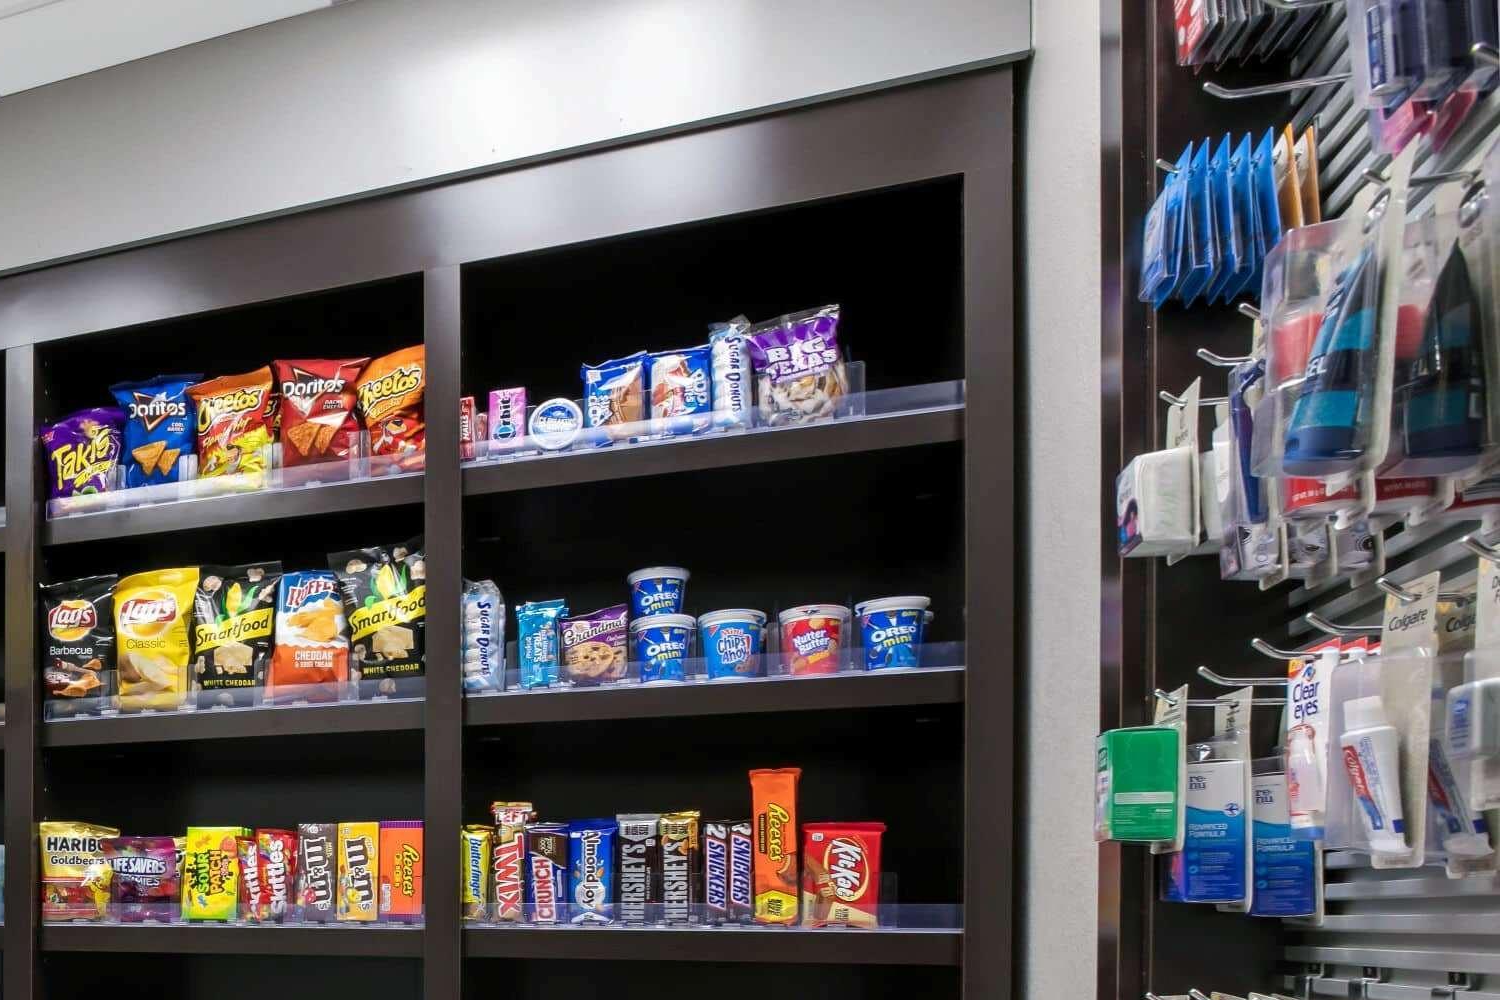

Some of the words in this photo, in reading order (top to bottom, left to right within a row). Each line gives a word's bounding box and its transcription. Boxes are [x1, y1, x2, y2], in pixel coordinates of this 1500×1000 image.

[766, 336, 826, 363] BIG
[766, 348, 838, 384] TEXAS
[282, 377, 346, 397] Doritos
[129, 401, 187, 418] Doritos
[198, 387, 264, 434] Cheetos
[461, 411, 470, 440] HALLS
[51, 427, 112, 491] Takis
[640, 592, 678, 606] OREO
[650, 600, 674, 611] mini
[51, 603, 93, 628] Lay's
[123, 599, 177, 624] Lay's
[477, 600, 492, 635] SUGAR
[1388, 607, 1428, 633] Colgate
[195, 613, 270, 646] Smartfood
[793, 630, 827, 647] Nutter
[871, 626, 917, 642] OREO
[50, 645, 93, 656] Barbecue
[126, 638, 166, 650] Classic
[533, 632, 543, 662] TREATS
[647, 642, 685, 656] OREO
[717, 637, 746, 652] Chips
[799, 637, 831, 655] Butter
[884, 636, 912, 648] mini
[295, 650, 333, 661] CHEDDAR
[477, 637, 491, 676] DONUTS
[656, 649, 681, 661] mini
[363, 666, 384, 675] WHITE
[385, 663, 420, 672] CHEDDAR
[203, 679, 225, 687] WHITE
[225, 679, 256, 687] CHEDDAR
[1292, 680, 1320, 703] Clear
[1293, 698, 1319, 723] eyes
[1188, 781, 1206, 790] nu
[1255, 795, 1274, 804] nu
[707, 824, 727, 839] 2
[767, 803, 790, 862] Reese's
[1188, 823, 1229, 831] ADVANCED
[1188, 830, 1227, 838] FORMULA
[50, 855, 105, 865] Goldbears
[582, 829, 601, 884] Almond
[1256, 844, 1295, 852] FORMULA
[128, 857, 167, 874] SAVERS
[197, 852, 209, 894] SOUR
[209, 850, 221, 895] PATCH
[266, 839, 287, 914] Skittles
[402, 842, 420, 898] Reese's
[469, 837, 482, 898] Butterfinger
[494, 831, 524, 918] TWIX
[708, 841, 726, 908] SNICKERS
[732, 837, 750, 905] SNICKERS
[536, 858, 555, 919] CRUNCH
[621, 844, 647, 924] HERSHEY'S
[663, 842, 689, 924] HERSHEY'S
[582, 884, 599, 908] Joy
